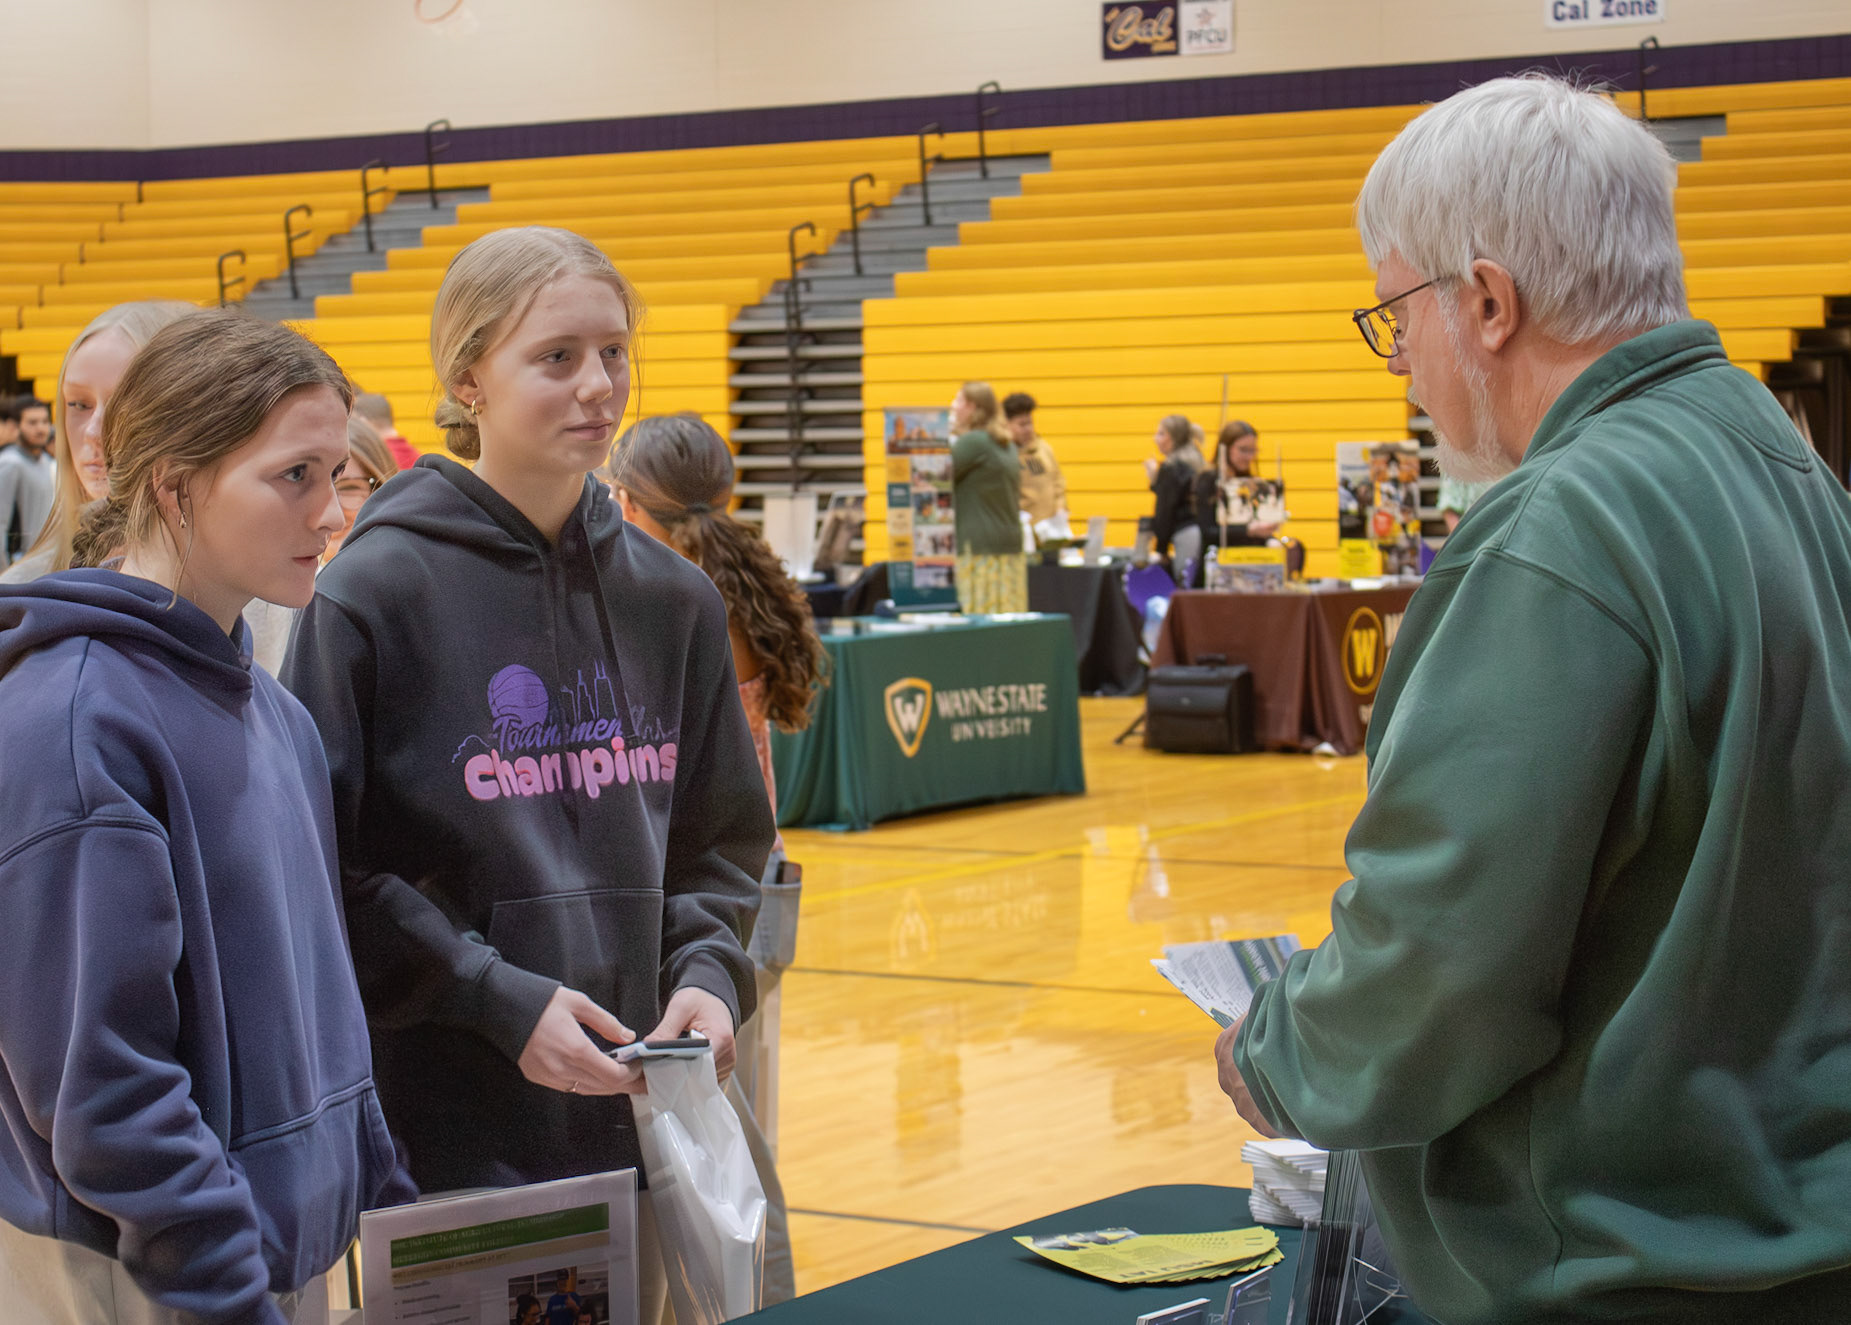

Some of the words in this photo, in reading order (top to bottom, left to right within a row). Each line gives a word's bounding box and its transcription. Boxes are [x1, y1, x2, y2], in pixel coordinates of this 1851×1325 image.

[1552, 0, 1588, 21] Cal
[1600, 0, 1658, 17] Zone
[893, 693, 926, 734] W
[935, 687, 996, 719] WAYNE
[998, 683, 1048, 714] STATE
